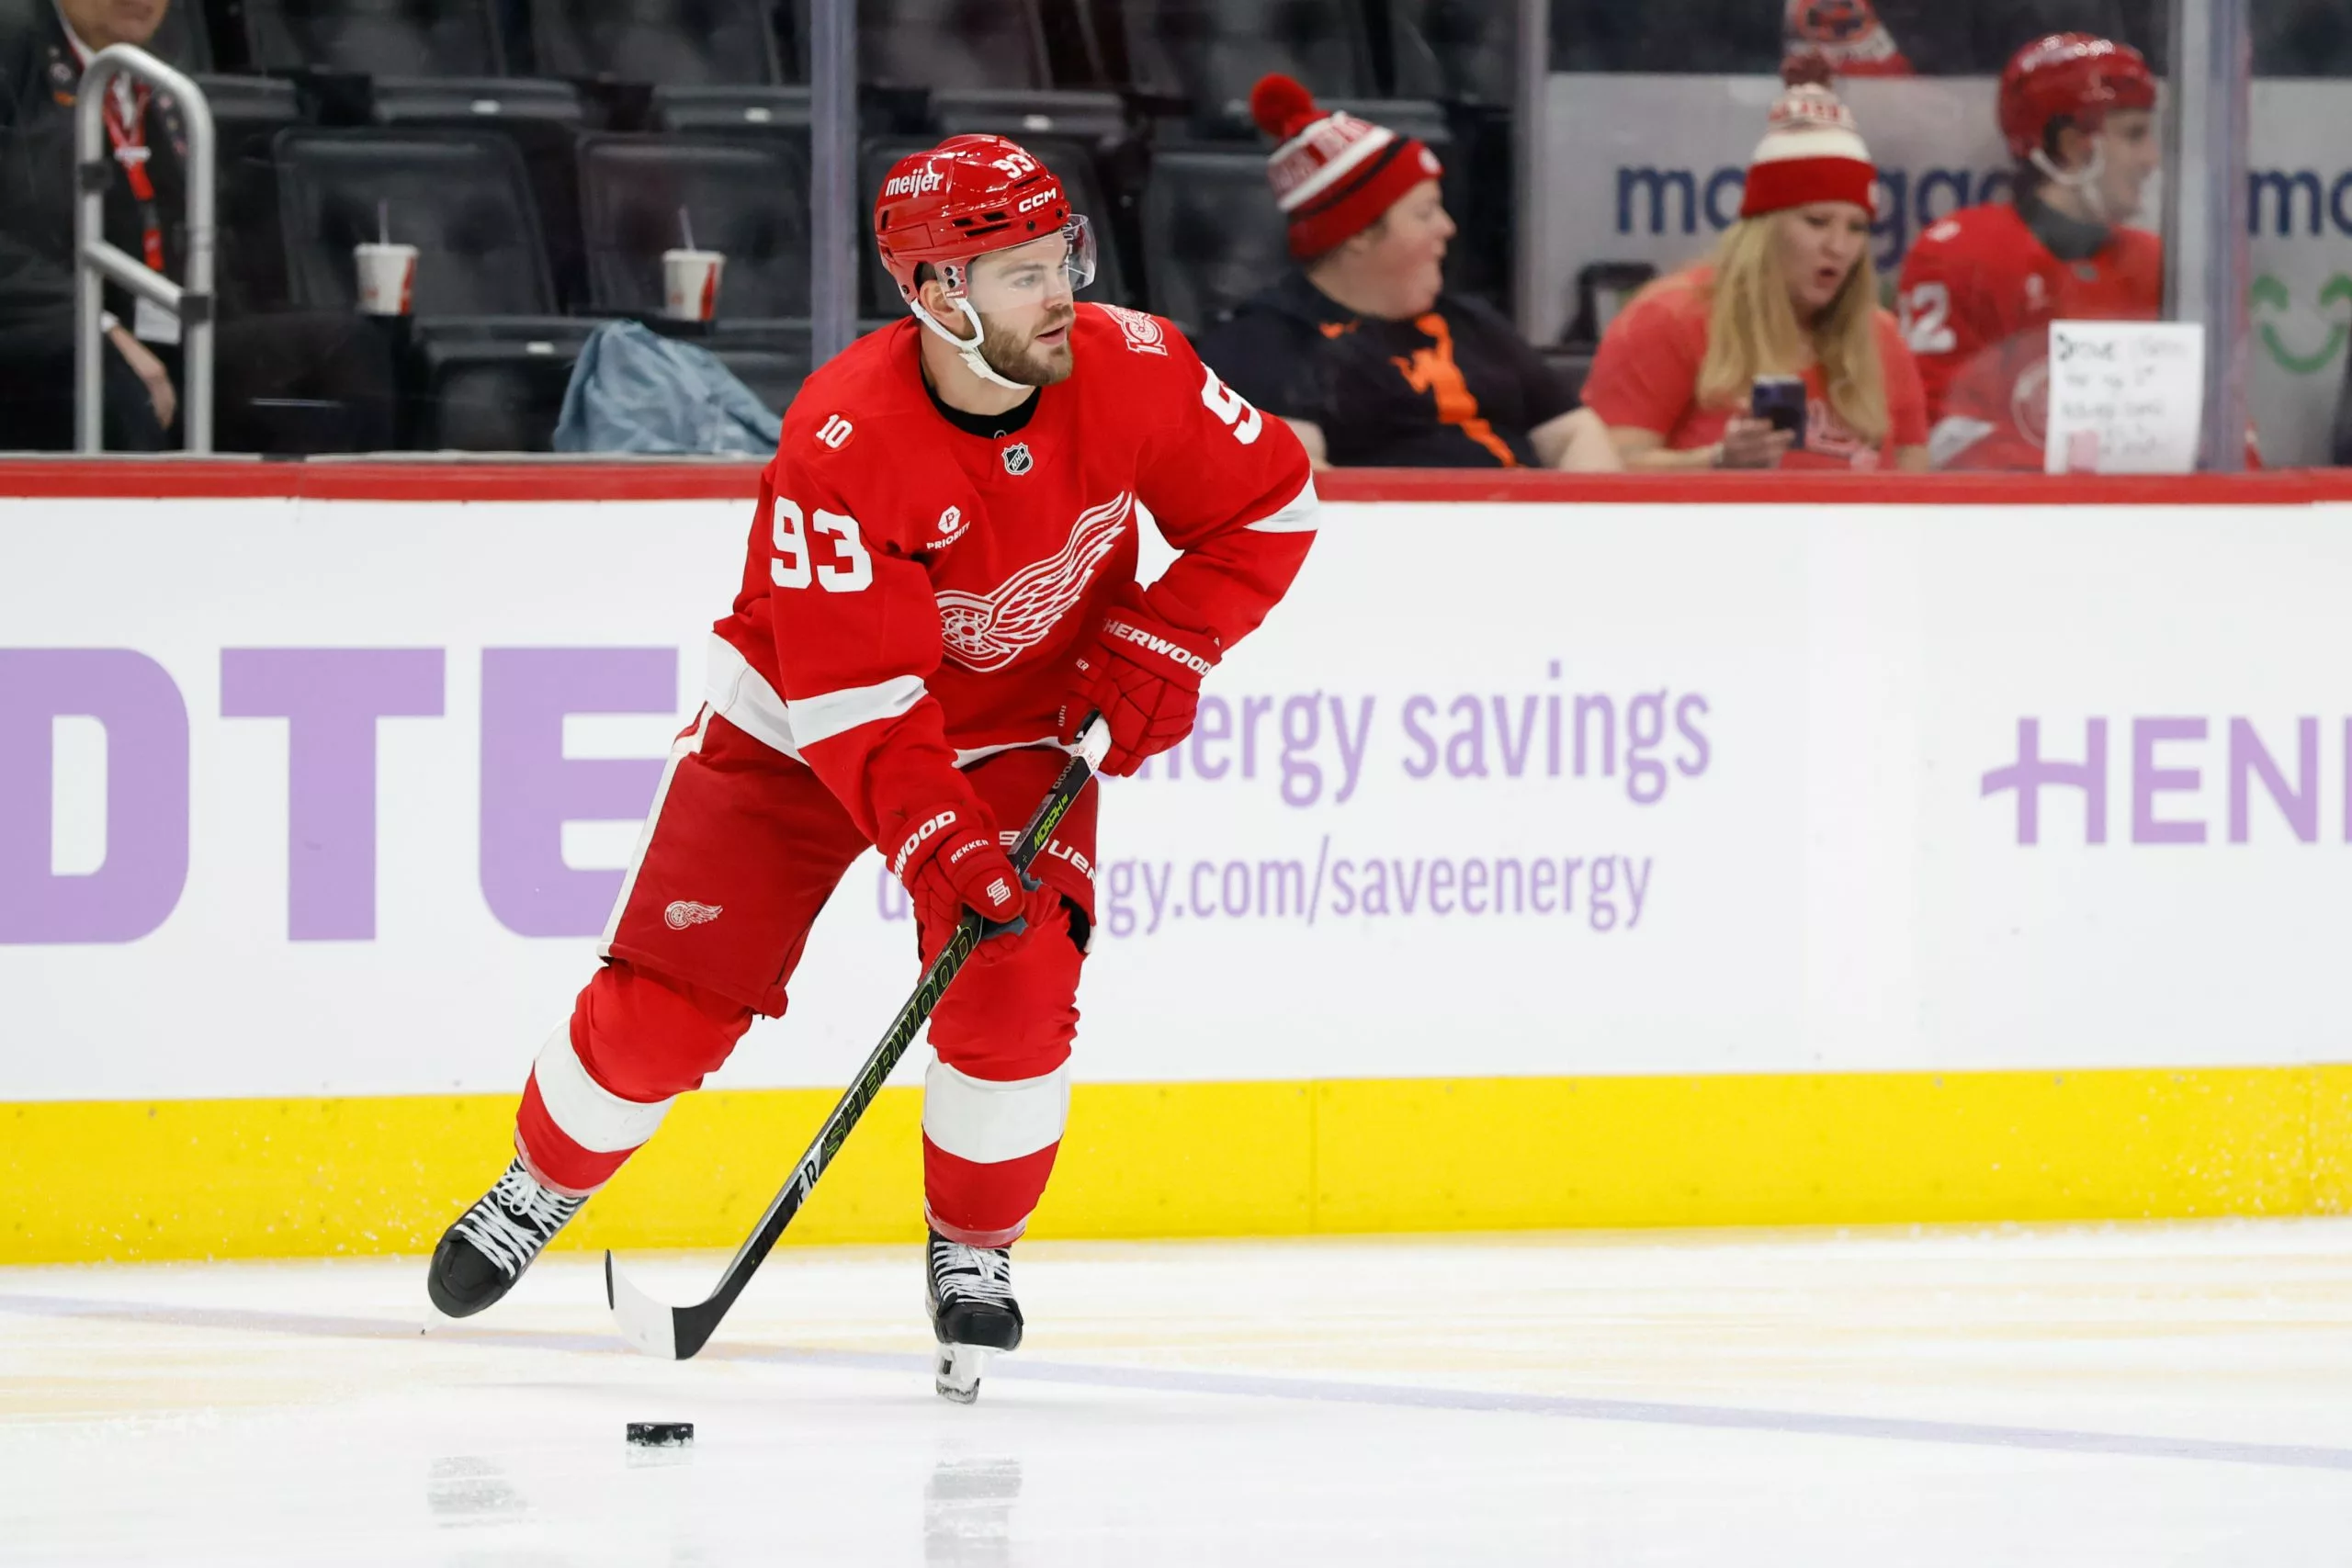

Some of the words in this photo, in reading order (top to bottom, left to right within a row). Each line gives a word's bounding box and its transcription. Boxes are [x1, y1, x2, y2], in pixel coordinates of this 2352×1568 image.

[992, 152, 1035, 179] 93
[885, 168, 944, 198] meijer
[1019, 186, 1057, 213] CCM
[816, 413, 854, 449] 10
[1011, 450, 1026, 471] NHL
[770, 495, 874, 593] 93
[926, 521, 970, 551] PRIORITY
[1401, 659, 1713, 805] savings
[1980, 716, 2352, 847] HEN
[1034, 800, 1064, 852] MORPH
[950, 838, 989, 864] REKKER
[825, 925, 974, 1165] SHERWOOD
